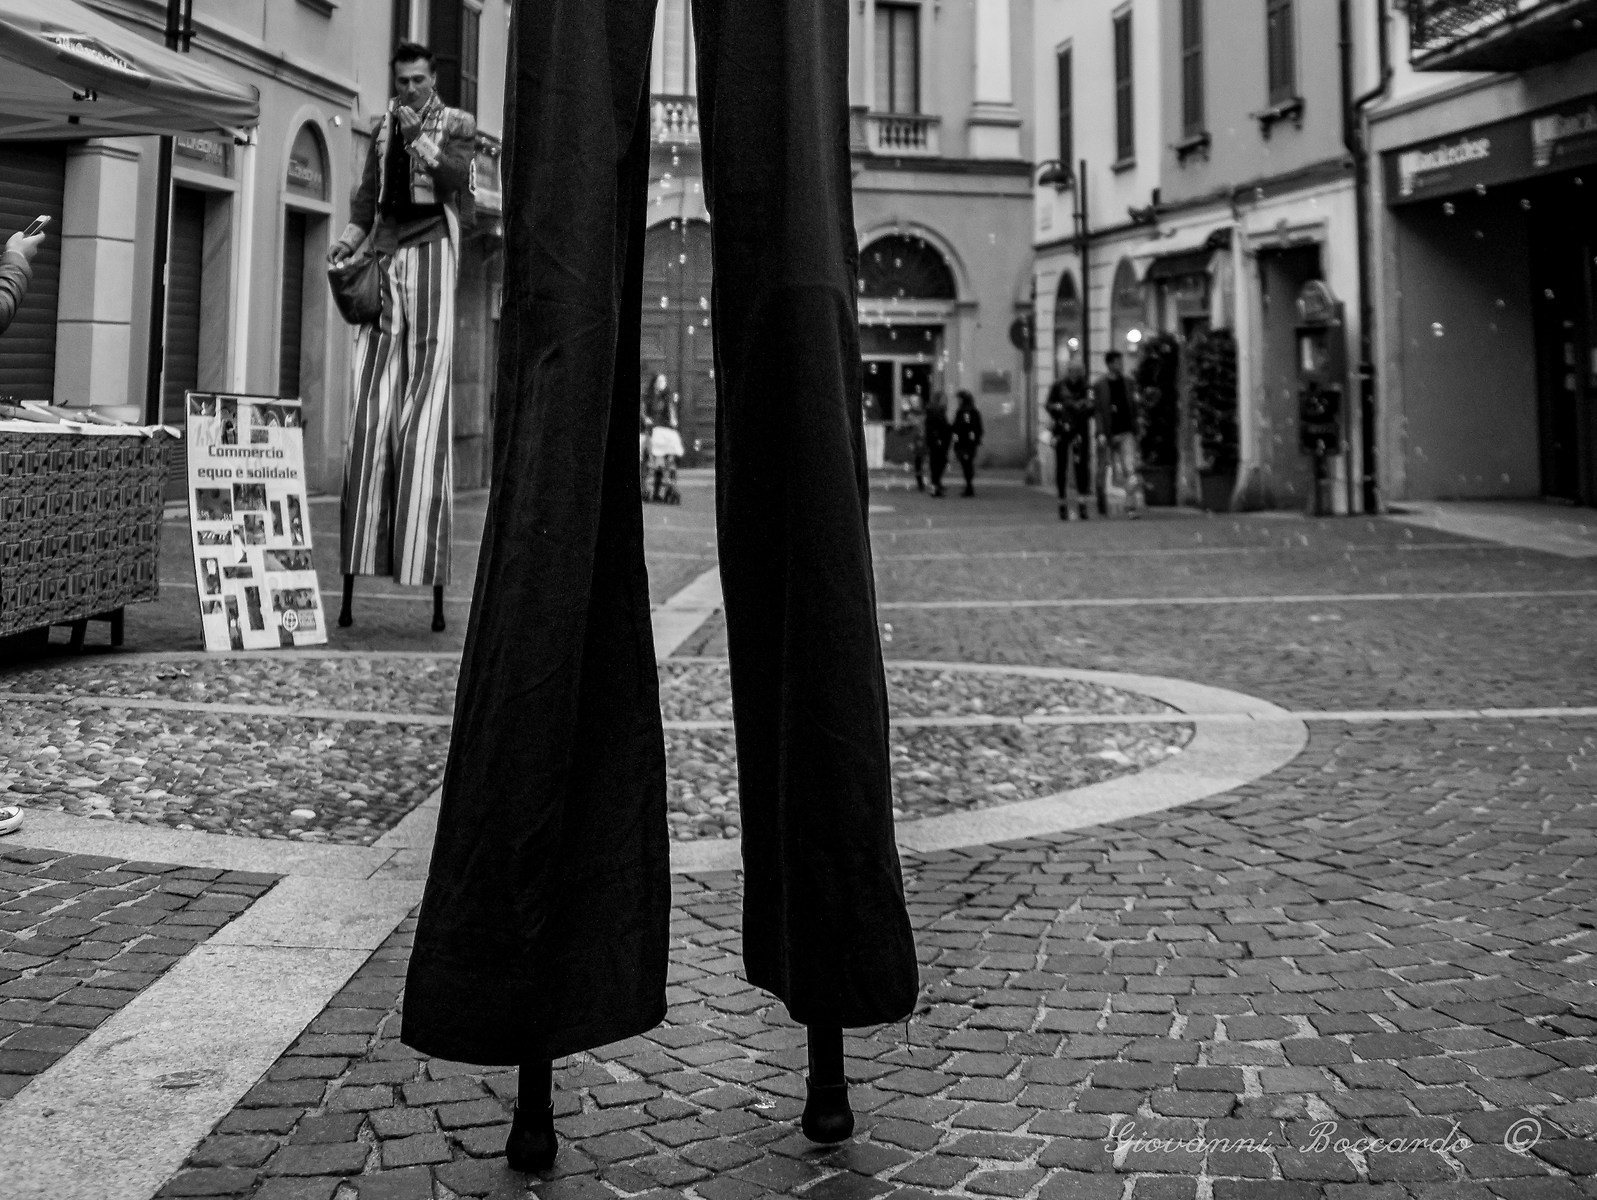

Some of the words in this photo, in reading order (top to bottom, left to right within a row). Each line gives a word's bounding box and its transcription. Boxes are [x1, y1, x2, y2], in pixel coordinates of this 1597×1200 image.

[208, 445, 284, 459] Commercio
[197, 468, 233, 481] equo
[247, 466, 298, 480] solidale
